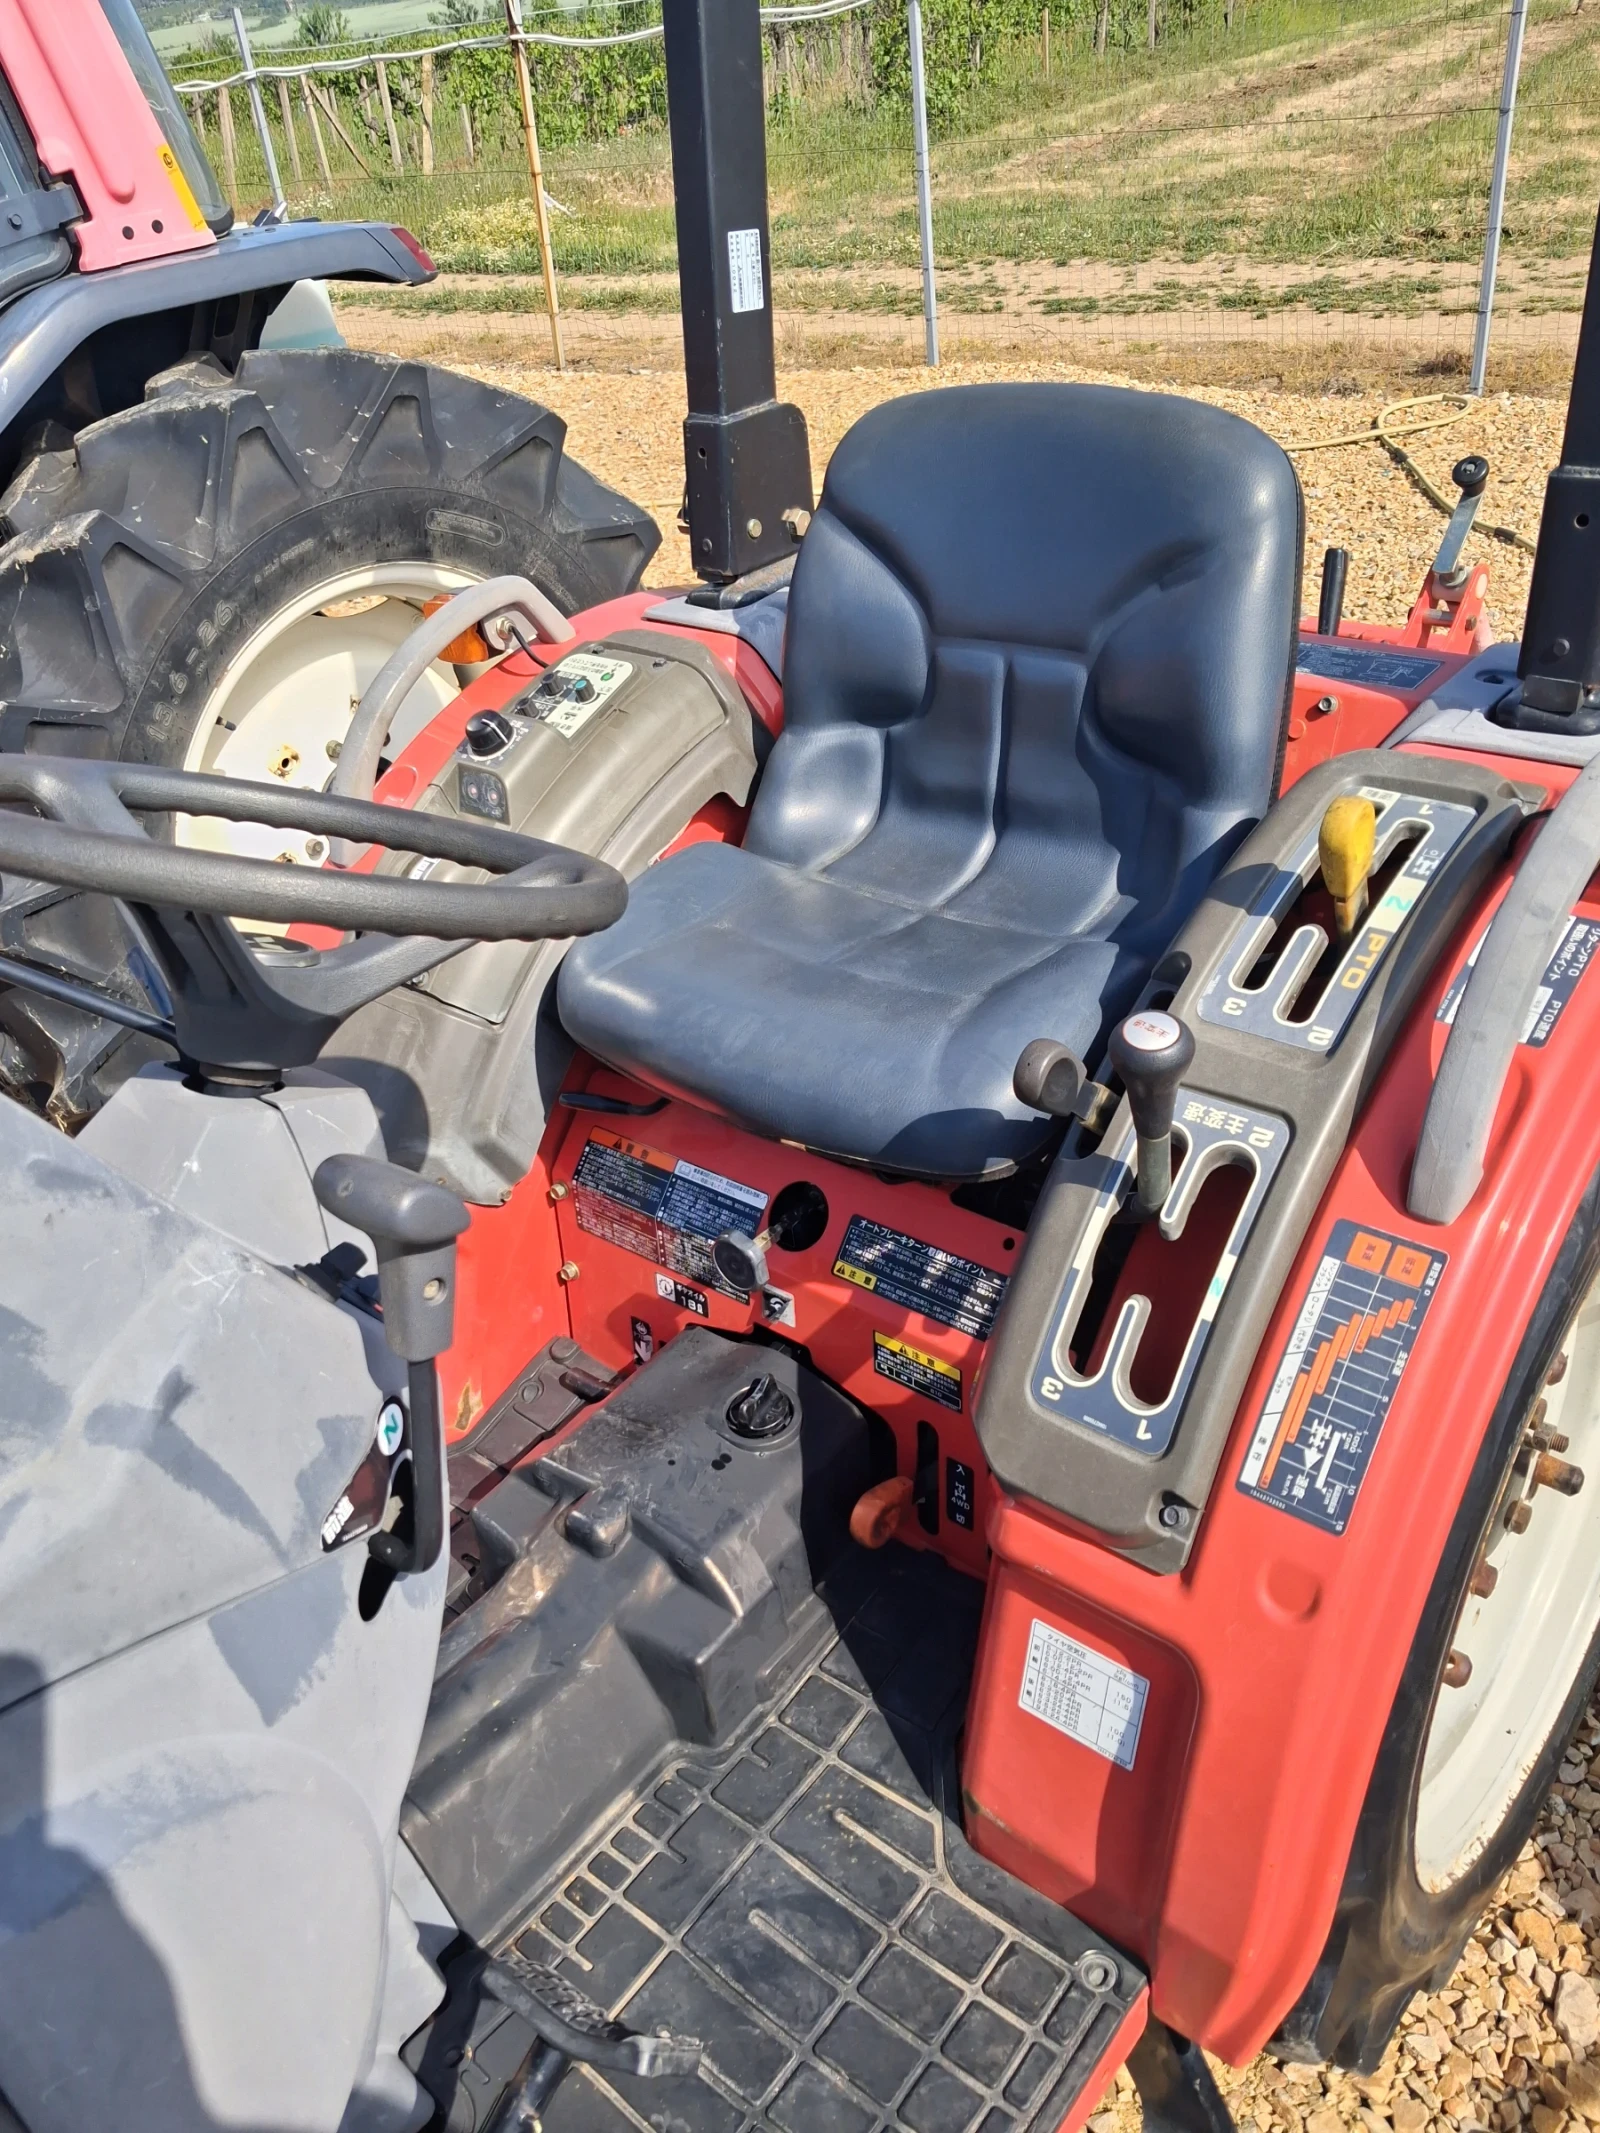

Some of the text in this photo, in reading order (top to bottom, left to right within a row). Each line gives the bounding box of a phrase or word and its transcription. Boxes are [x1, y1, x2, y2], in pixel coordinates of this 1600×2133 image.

[1383, 895, 1413, 912] N
[1341, 931, 1387, 990] PTO
[1222, 997, 1246, 1016] 3
[1308, 1026, 1334, 1045] 2
[1187, 1100, 1276, 1148] 2 主変速
[858, 1218, 987, 1278] オートブレーキターン取扱いのポイント
[848, 1267, 872, 1288] 注意
[1208, 1278, 1222, 1299] N
[1391, 1350, 1408, 1377] 主変速
[1041, 1377, 1061, 1400] 3
[1381, 1395, 1389, 1403] 5
[383, 1412, 399, 1446] N
[1135, 1419, 1153, 1441] 1
[1342, 1433, 1353, 1450] rpm
[1348, 1430, 1362, 1453] 1000
[1322, 1487, 1333, 1505] rpm
[1347, 1484, 1356, 1495] 10
[951, 1497, 970, 1510] 4WD
[1046, 1632, 1087, 1659] タイヤ空気圧
